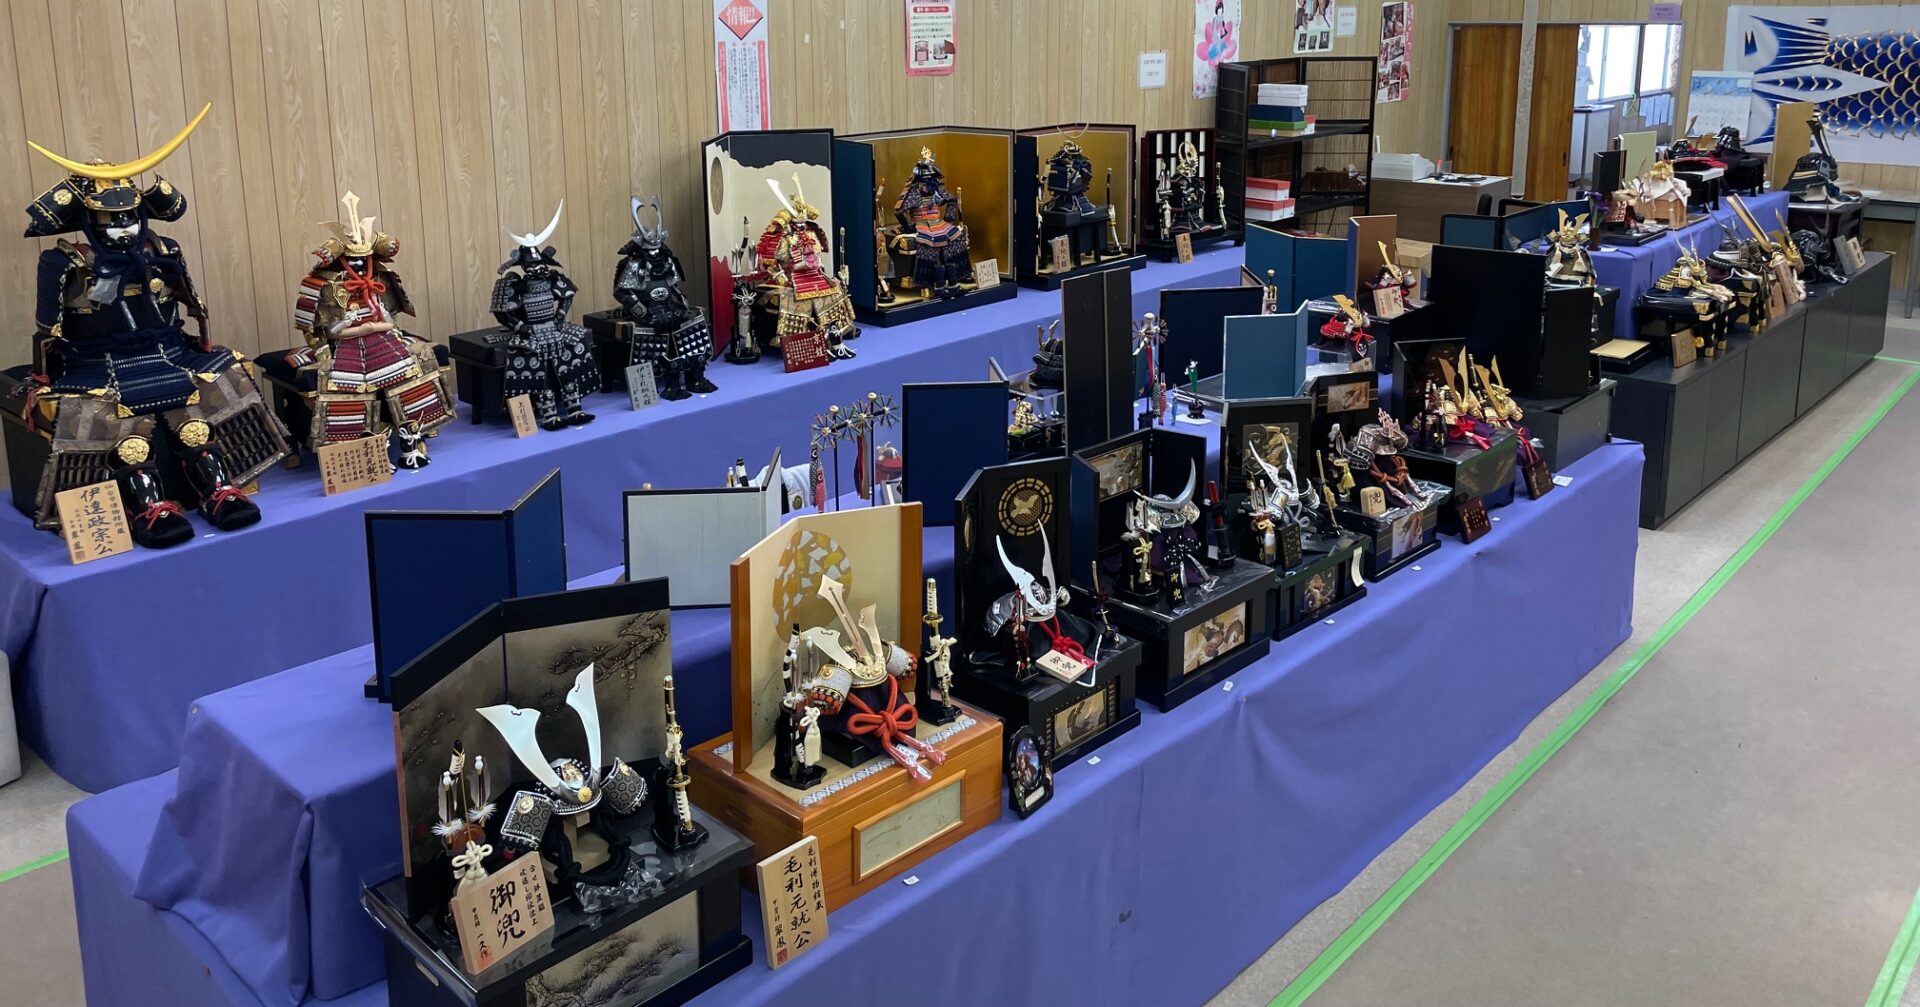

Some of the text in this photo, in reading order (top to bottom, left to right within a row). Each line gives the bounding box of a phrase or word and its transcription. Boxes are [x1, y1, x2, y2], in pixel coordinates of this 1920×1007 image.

[80, 486, 113, 555] 伊達政宗公
[489, 880, 526, 949] 御兜
[783, 855, 812, 950] 毛利元就公
